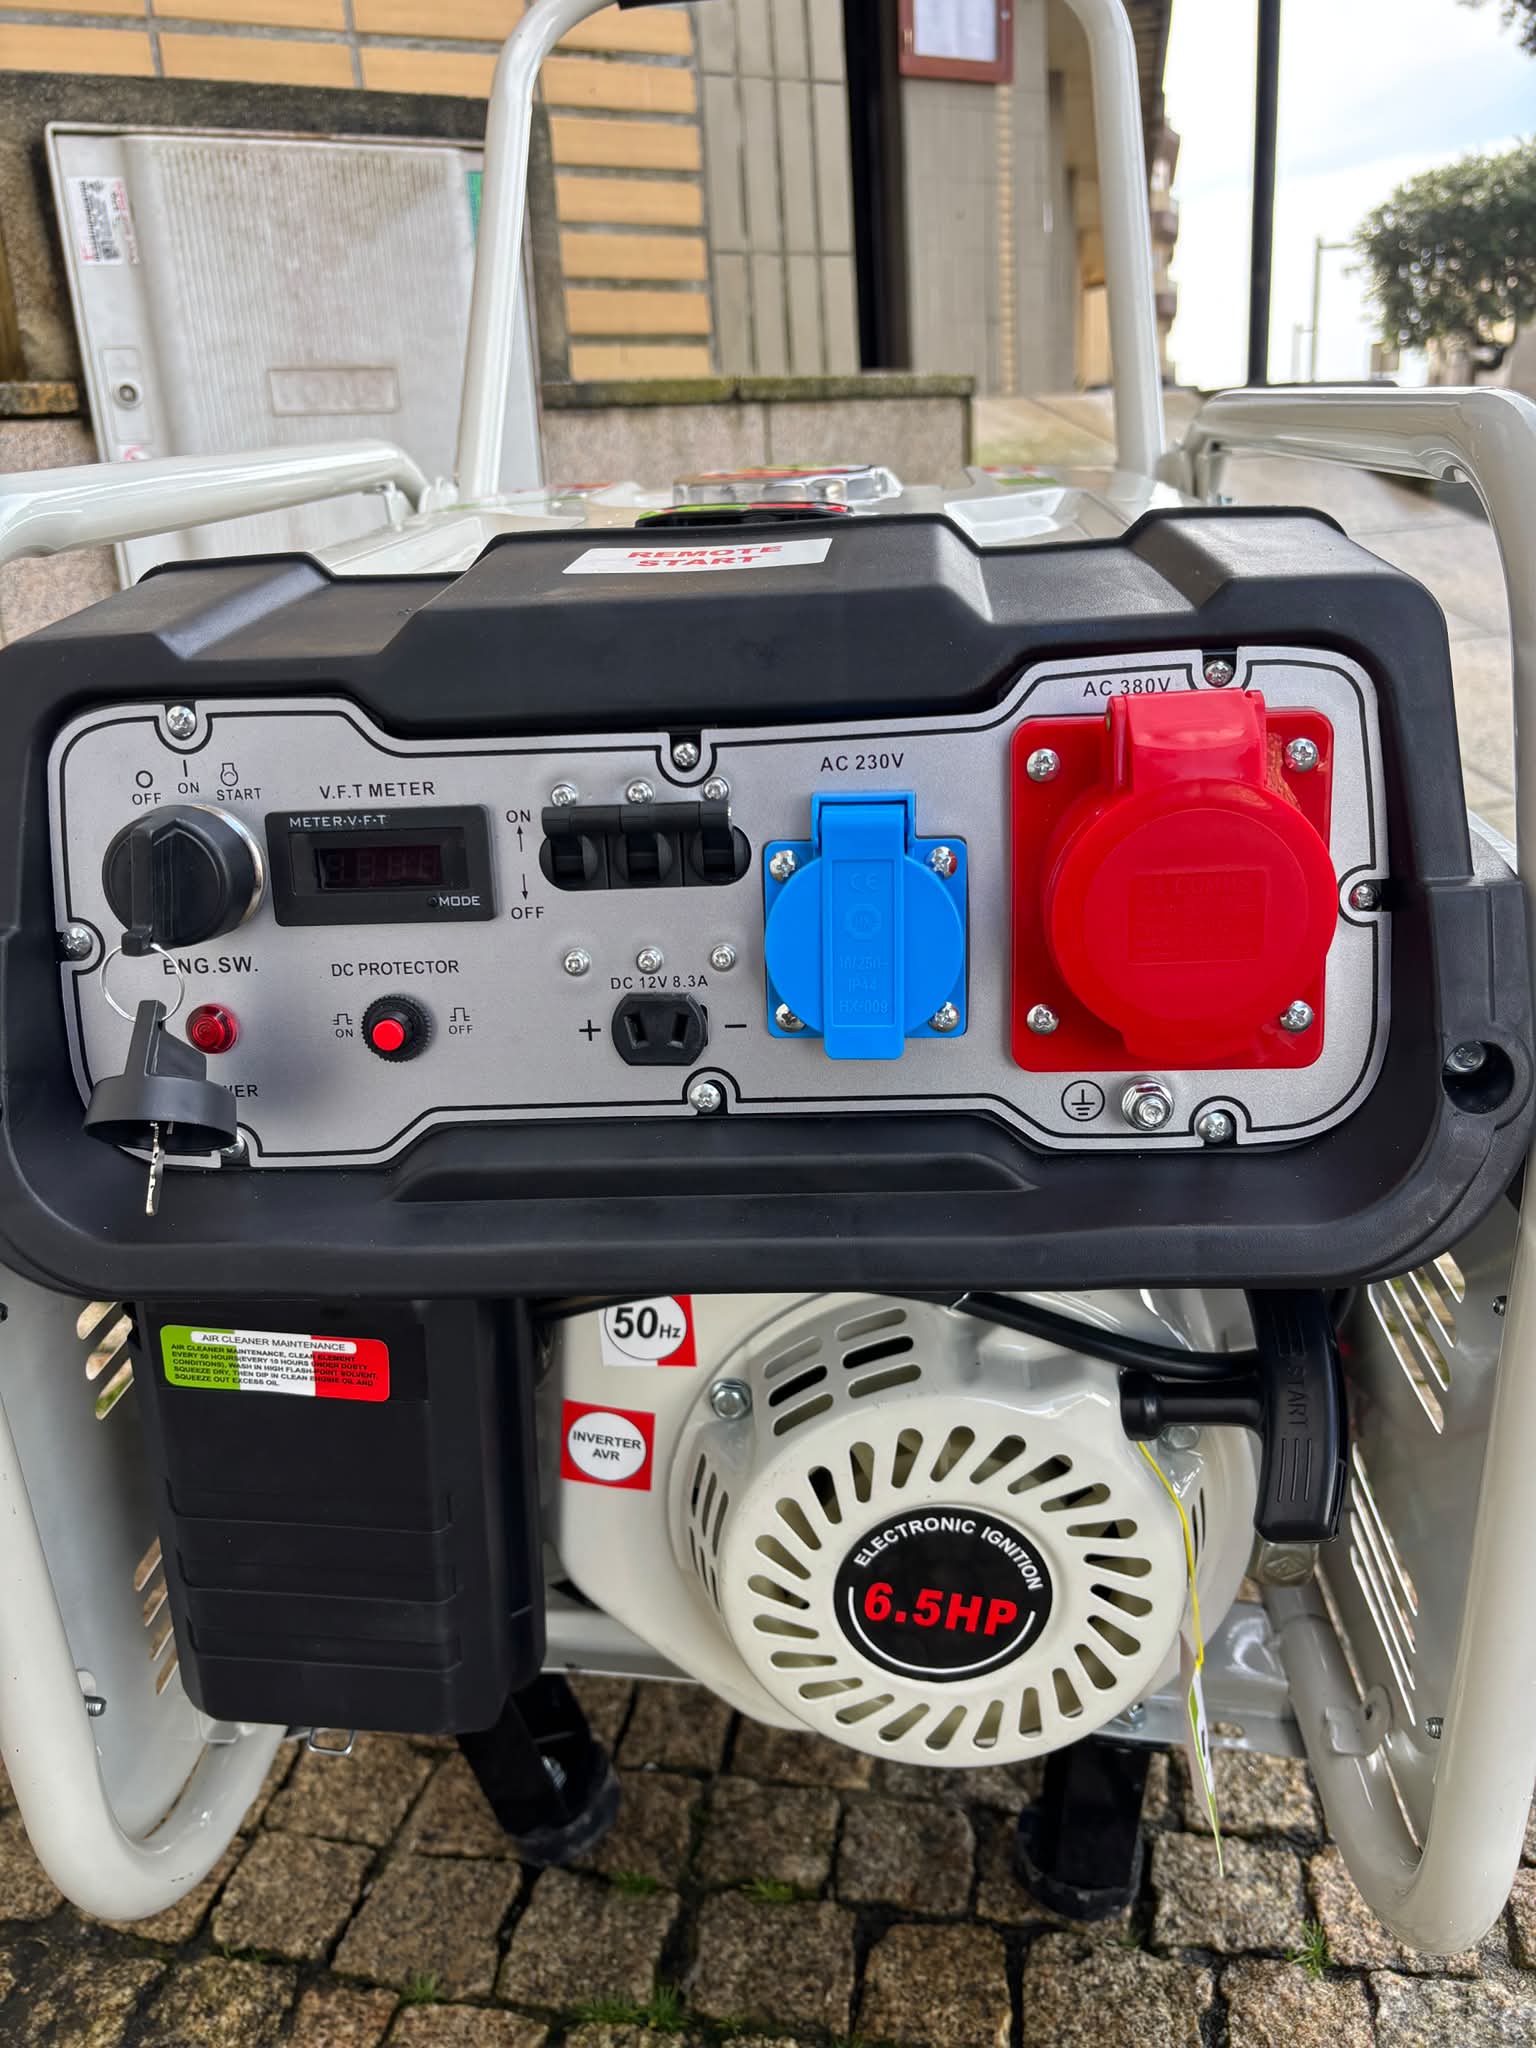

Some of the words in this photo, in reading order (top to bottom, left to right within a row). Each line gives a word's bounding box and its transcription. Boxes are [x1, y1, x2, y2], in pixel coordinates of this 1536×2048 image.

[629, 546, 782, 558] REMOTE
[639, 556, 761, 567] START
[1083, 679, 1113, 697] AC
[1119, 677, 1171, 695] 380V
[820, 756, 849, 772] AC
[855, 753, 904, 770] 230V
[178, 782, 200, 795] ON
[216, 787, 262, 801] START
[319, 784, 365, 800] V.F.T
[369, 781, 435, 799] METER
[132, 792, 162, 806] OFF
[506, 809, 531, 823] ON
[439, 895, 481, 907] MODE
[511, 906, 545, 920] OFF
[163, 956, 260, 976] ENG.SW.
[331, 963, 354, 977] DC
[358, 960, 459, 976] PROTECTOR
[610, 977, 634, 990] DC
[639, 975, 668, 989] 12V
[672, 974, 709, 988] 8.3A
[335, 1028, 354, 1039] ON
[448, 1024, 473, 1035] OFF
[202, 1334, 219, 1343] AIR
[221, 1336, 270, 1346] CLEANER
[271, 1339, 346, 1352] MAINTENANCE
[573, 1430, 641, 1450] INVERTER
[592, 1448, 620, 1462] AVR
[853, 1516, 977, 1568] ELECTRONIC
[980, 1525, 1044, 1592] IGNITION
[864, 1581, 1018, 1637] 6.5HP
